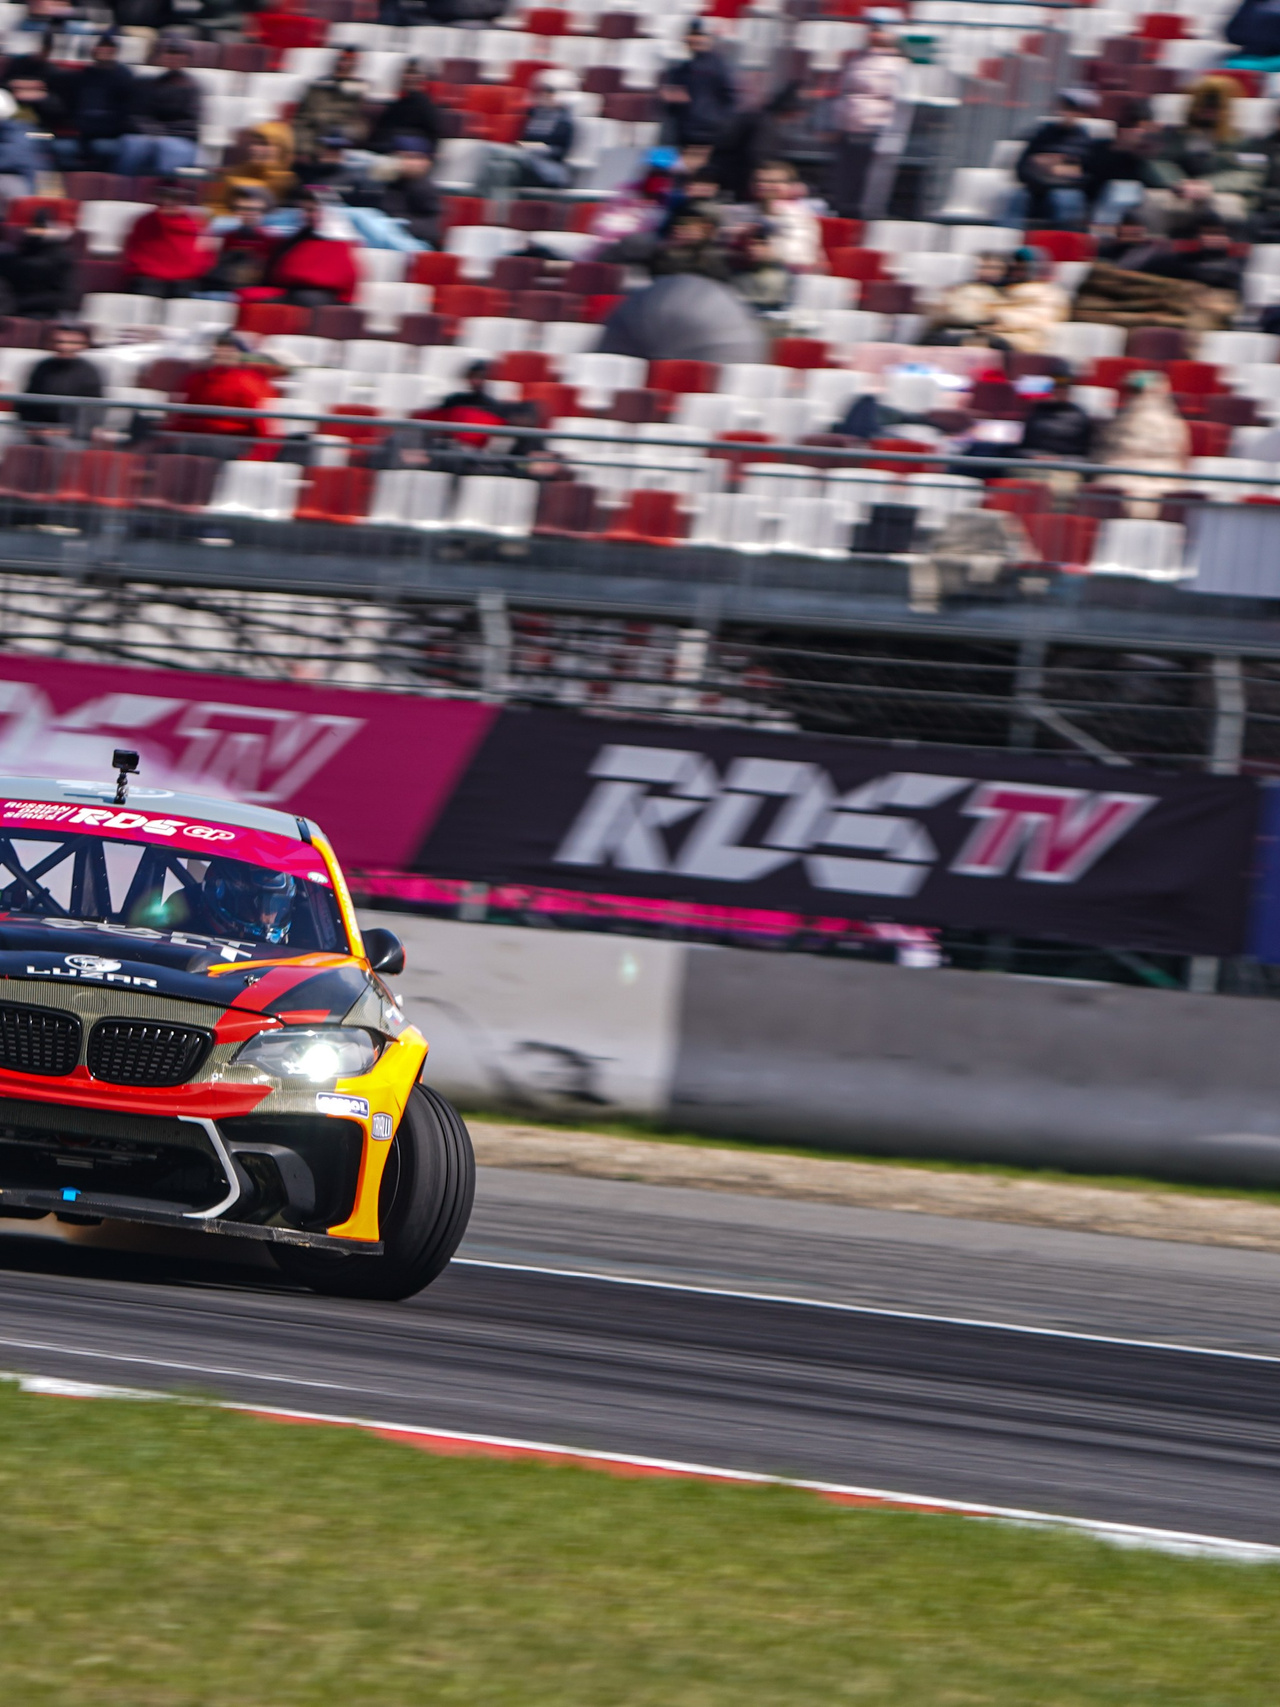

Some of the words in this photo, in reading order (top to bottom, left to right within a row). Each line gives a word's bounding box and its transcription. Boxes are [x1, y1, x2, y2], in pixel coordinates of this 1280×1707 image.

[166, 700, 368, 803] TV
[68, 807, 188, 836] RDS
[183, 825, 236, 841] GP
[552, 744, 976, 897] RDS
[947, 779, 1162, 884] TV
[26, 965, 158, 988] LUZAR
